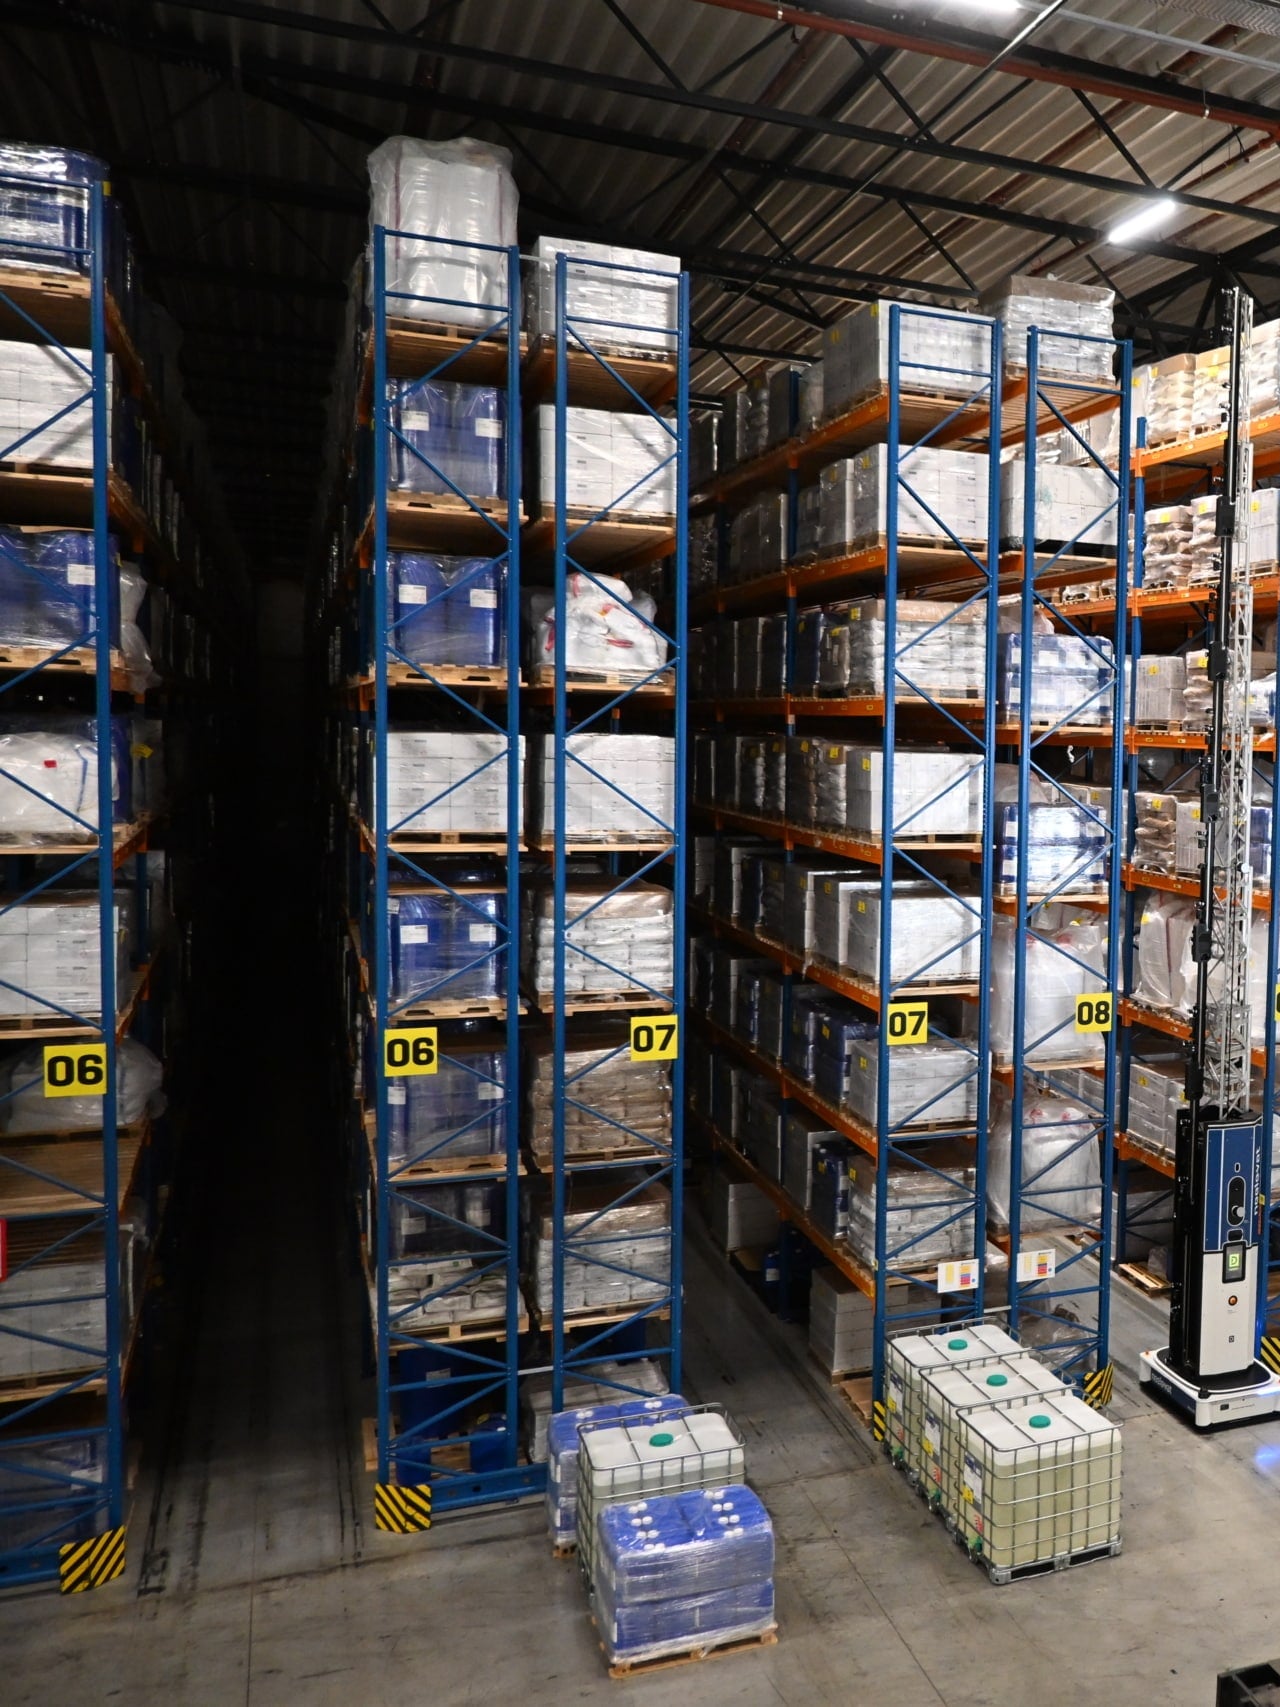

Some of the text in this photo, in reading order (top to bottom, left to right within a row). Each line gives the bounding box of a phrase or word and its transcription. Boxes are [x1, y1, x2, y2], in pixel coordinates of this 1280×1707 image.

[889, 1011, 926, 1037] 07
[1077, 1001, 1110, 1026] 08
[387, 1038, 435, 1067] 06
[633, 1024, 676, 1053] 07
[48, 1055, 103, 1087] 06
